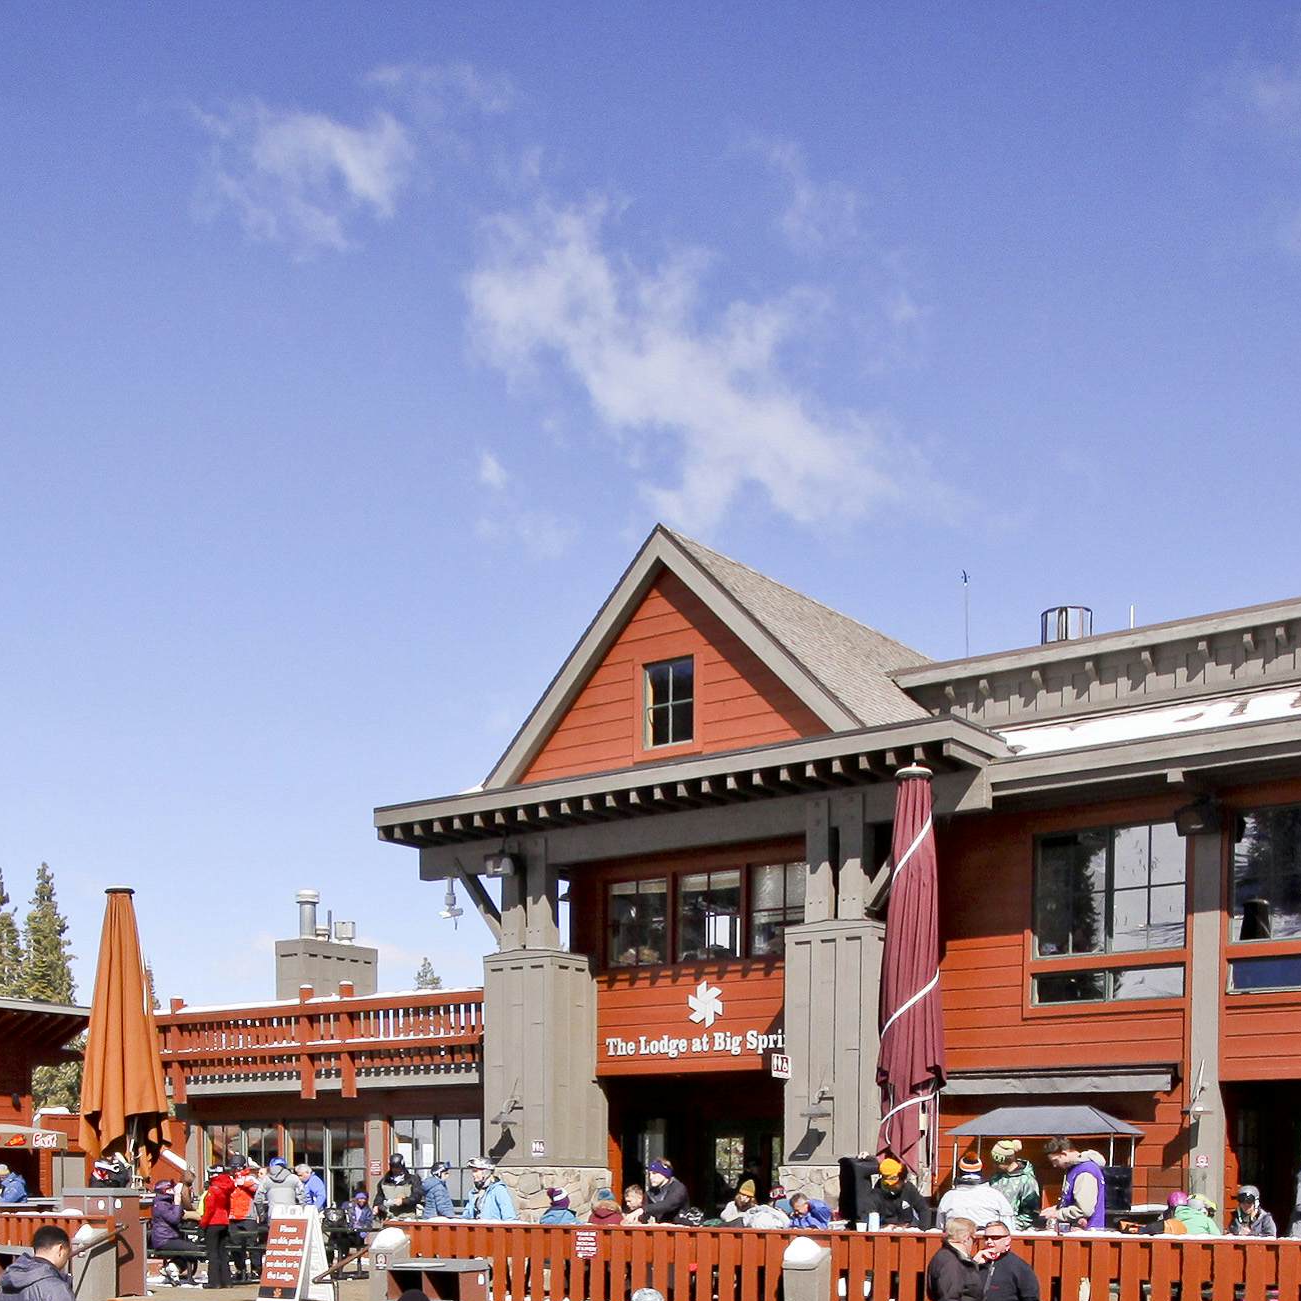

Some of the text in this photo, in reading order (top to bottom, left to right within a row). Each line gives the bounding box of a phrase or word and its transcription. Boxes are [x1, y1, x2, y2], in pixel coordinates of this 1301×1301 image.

[605, 1029, 785, 1058] The Lodge at Big Spri
[32, 1132, 57, 1148] Exit
